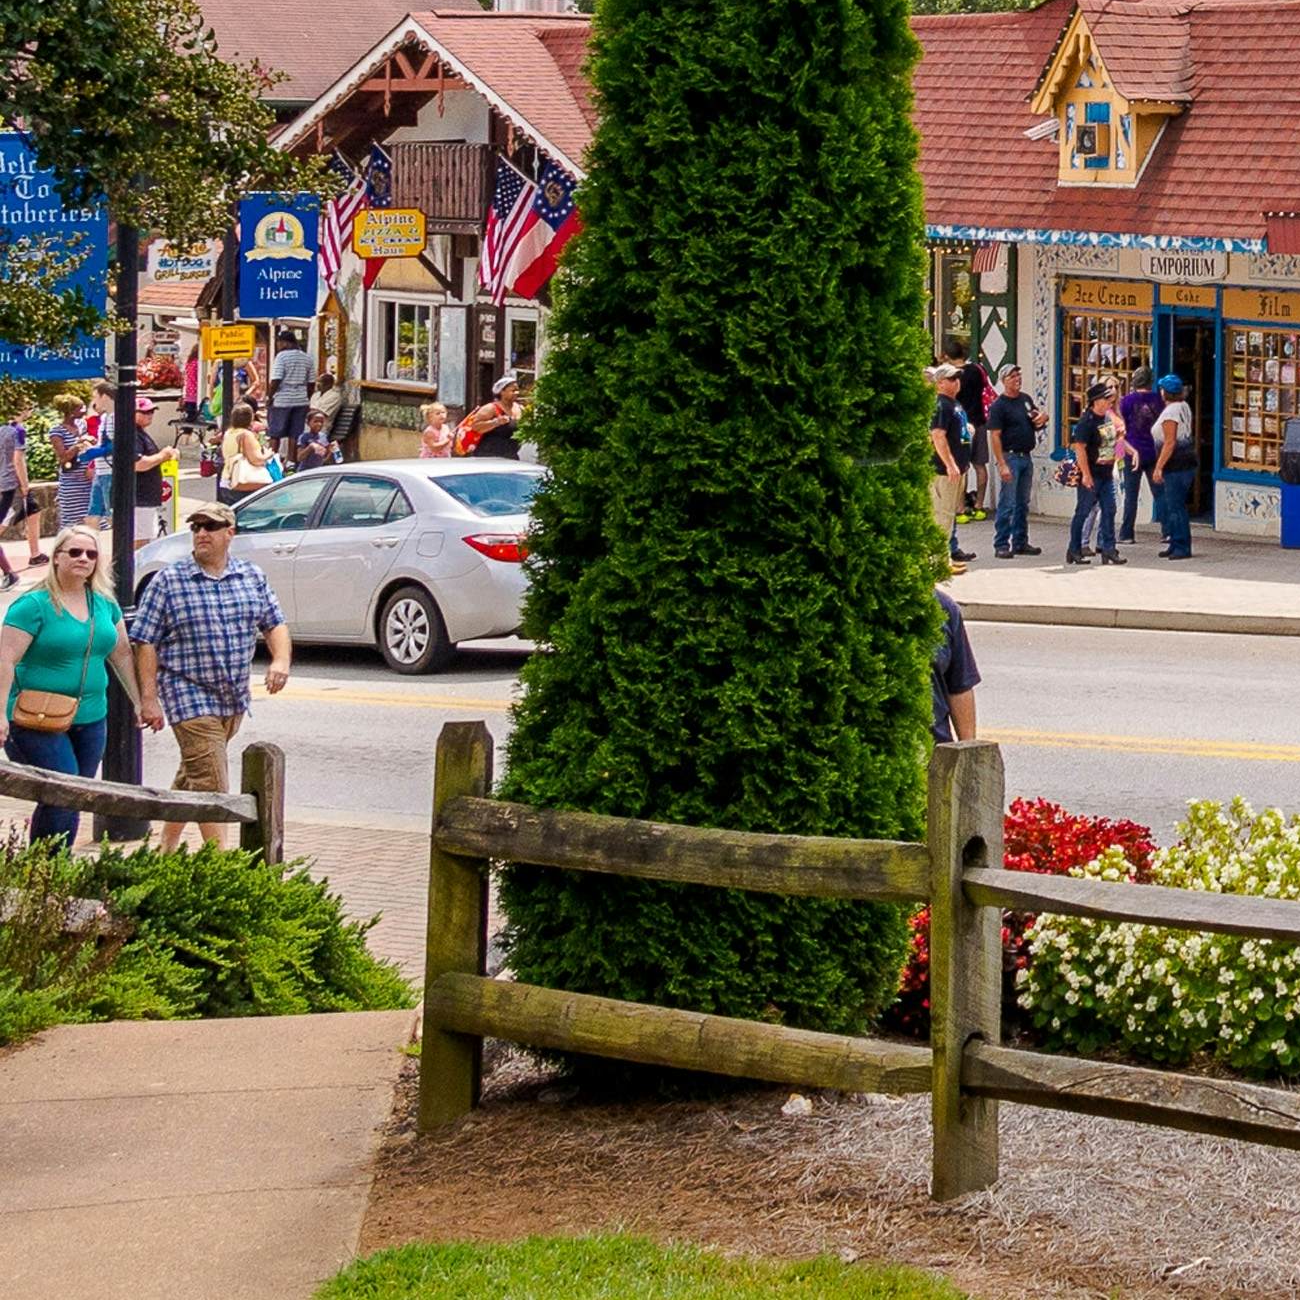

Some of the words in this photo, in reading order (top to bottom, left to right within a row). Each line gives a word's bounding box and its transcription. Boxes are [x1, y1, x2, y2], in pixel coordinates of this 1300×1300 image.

[14, 174, 49, 200] To
[0, 202, 101, 224] toberfest
[366, 211, 416, 227] Alpine
[256, 267, 303, 283] Alpine
[1150, 256, 1215, 277] EMPORIUM
[260, 286, 299, 300] Helen
[1074, 283, 1094, 303] Ice
[1097, 284, 1137, 306] Cream
[1258, 294, 1291, 317] Film
